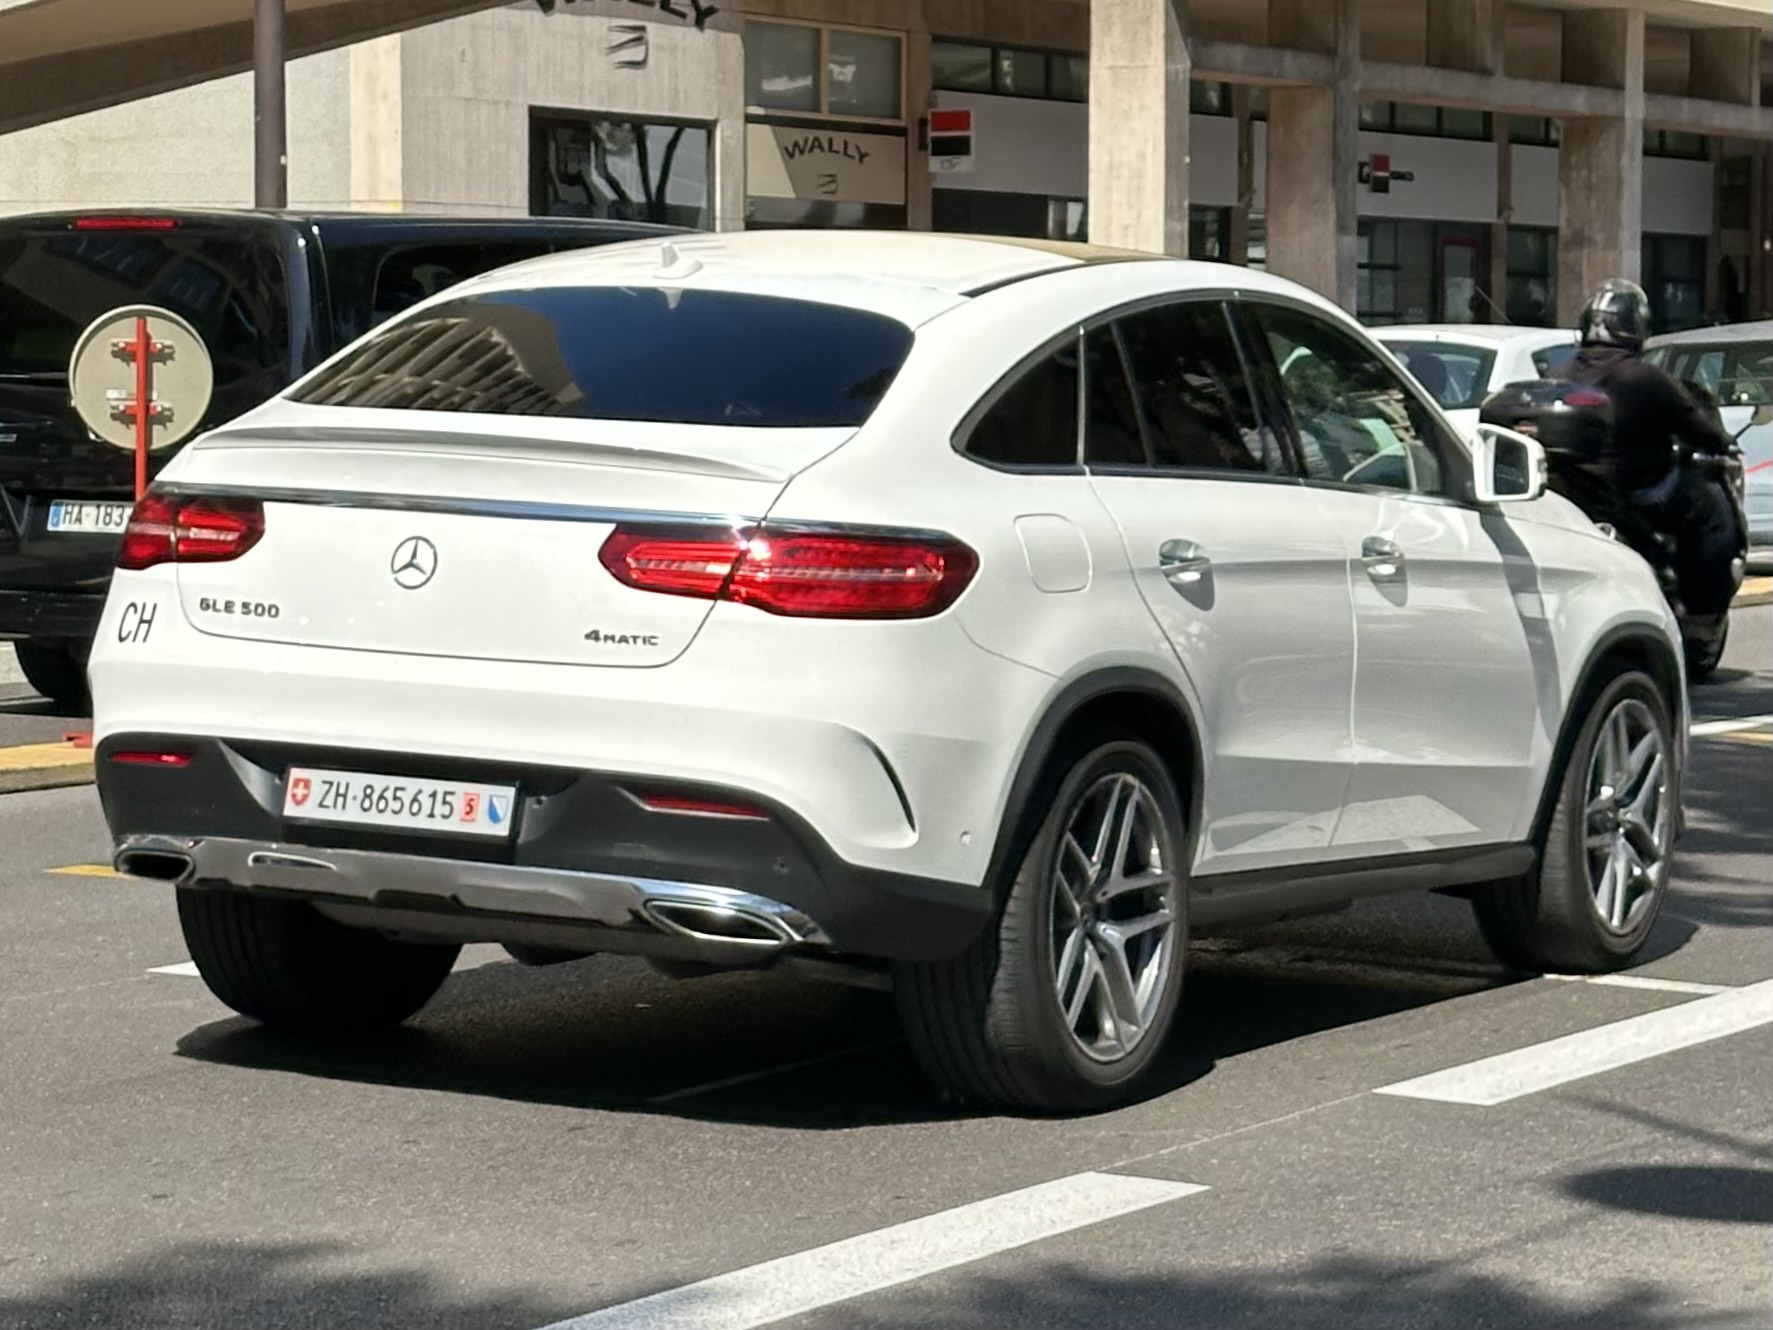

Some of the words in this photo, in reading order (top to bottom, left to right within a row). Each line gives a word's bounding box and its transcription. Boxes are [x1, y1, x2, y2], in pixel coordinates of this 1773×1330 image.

[784, 136, 870, 164] WALLY
[199, 597, 235, 614] GLE
[241, 601, 280, 618] 500
[117, 602, 157, 643] CH
[584, 629, 659, 646] 4MATIC
